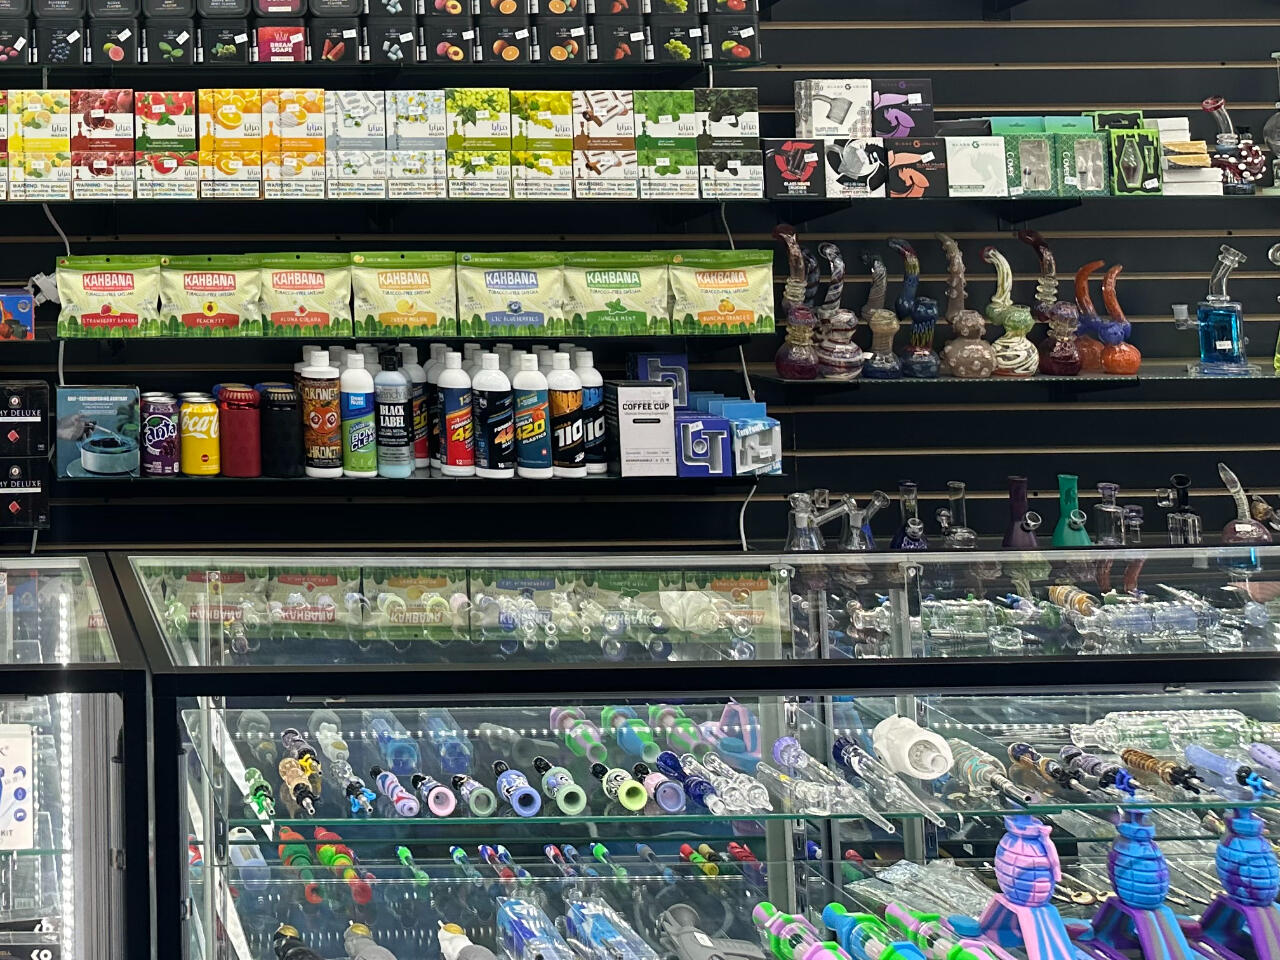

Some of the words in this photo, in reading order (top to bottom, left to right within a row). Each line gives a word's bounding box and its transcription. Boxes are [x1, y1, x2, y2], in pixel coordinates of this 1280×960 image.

[84, 274, 133, 286] KAHBANA
[185, 274, 235, 286] KAHBANA
[273, 272, 324, 285] KAHBANA
[379, 272, 429, 285] KAHBANA
[486, 271, 537, 285] KAHBANA
[587, 271, 640, 285] KAHBANA
[696, 272, 747, 284] KAHBANA
[380, 405, 405, 416] BLACK
[380, 416, 405, 427] LABEL
[452, 422, 474, 442] 42
[495, 424, 514, 445] 42
[11, 480, 42, 488] DELUXE
